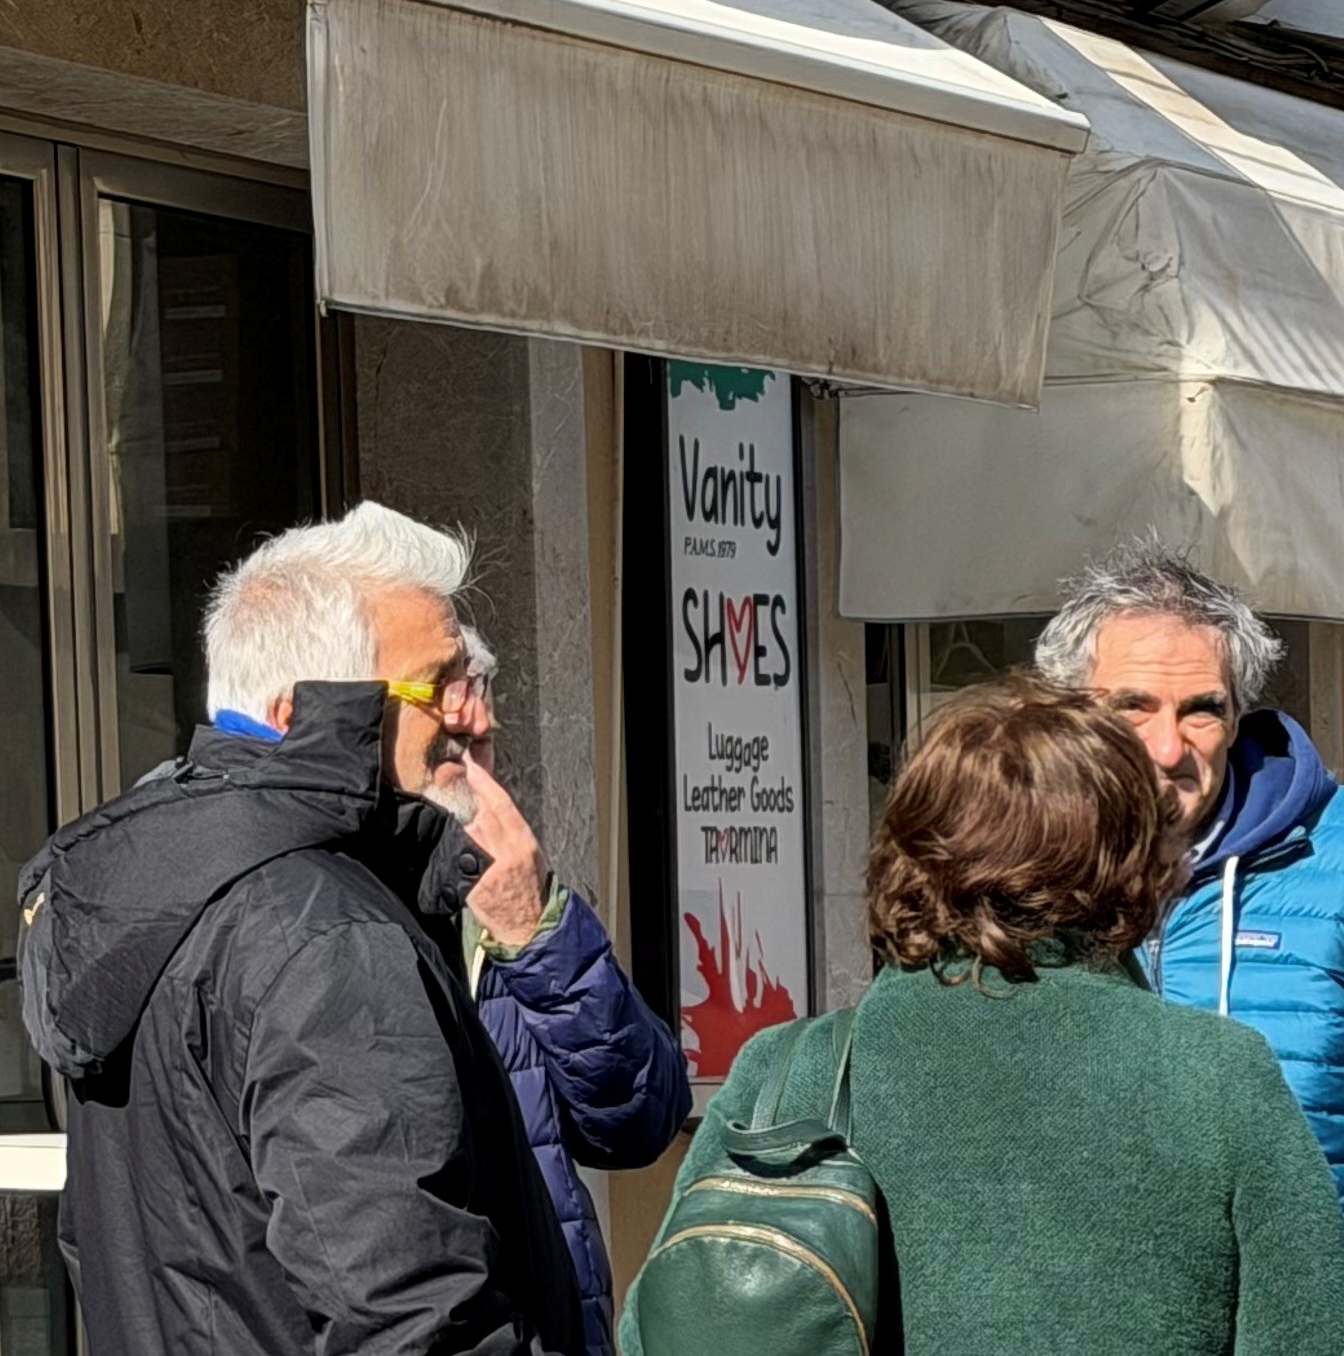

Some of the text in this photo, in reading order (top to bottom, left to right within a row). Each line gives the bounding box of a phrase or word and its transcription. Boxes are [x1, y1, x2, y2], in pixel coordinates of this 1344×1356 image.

[679, 433, 782, 557] Vanity
[707, 721, 770, 774] Luggage
[683, 773, 795, 813] Leather Goods
